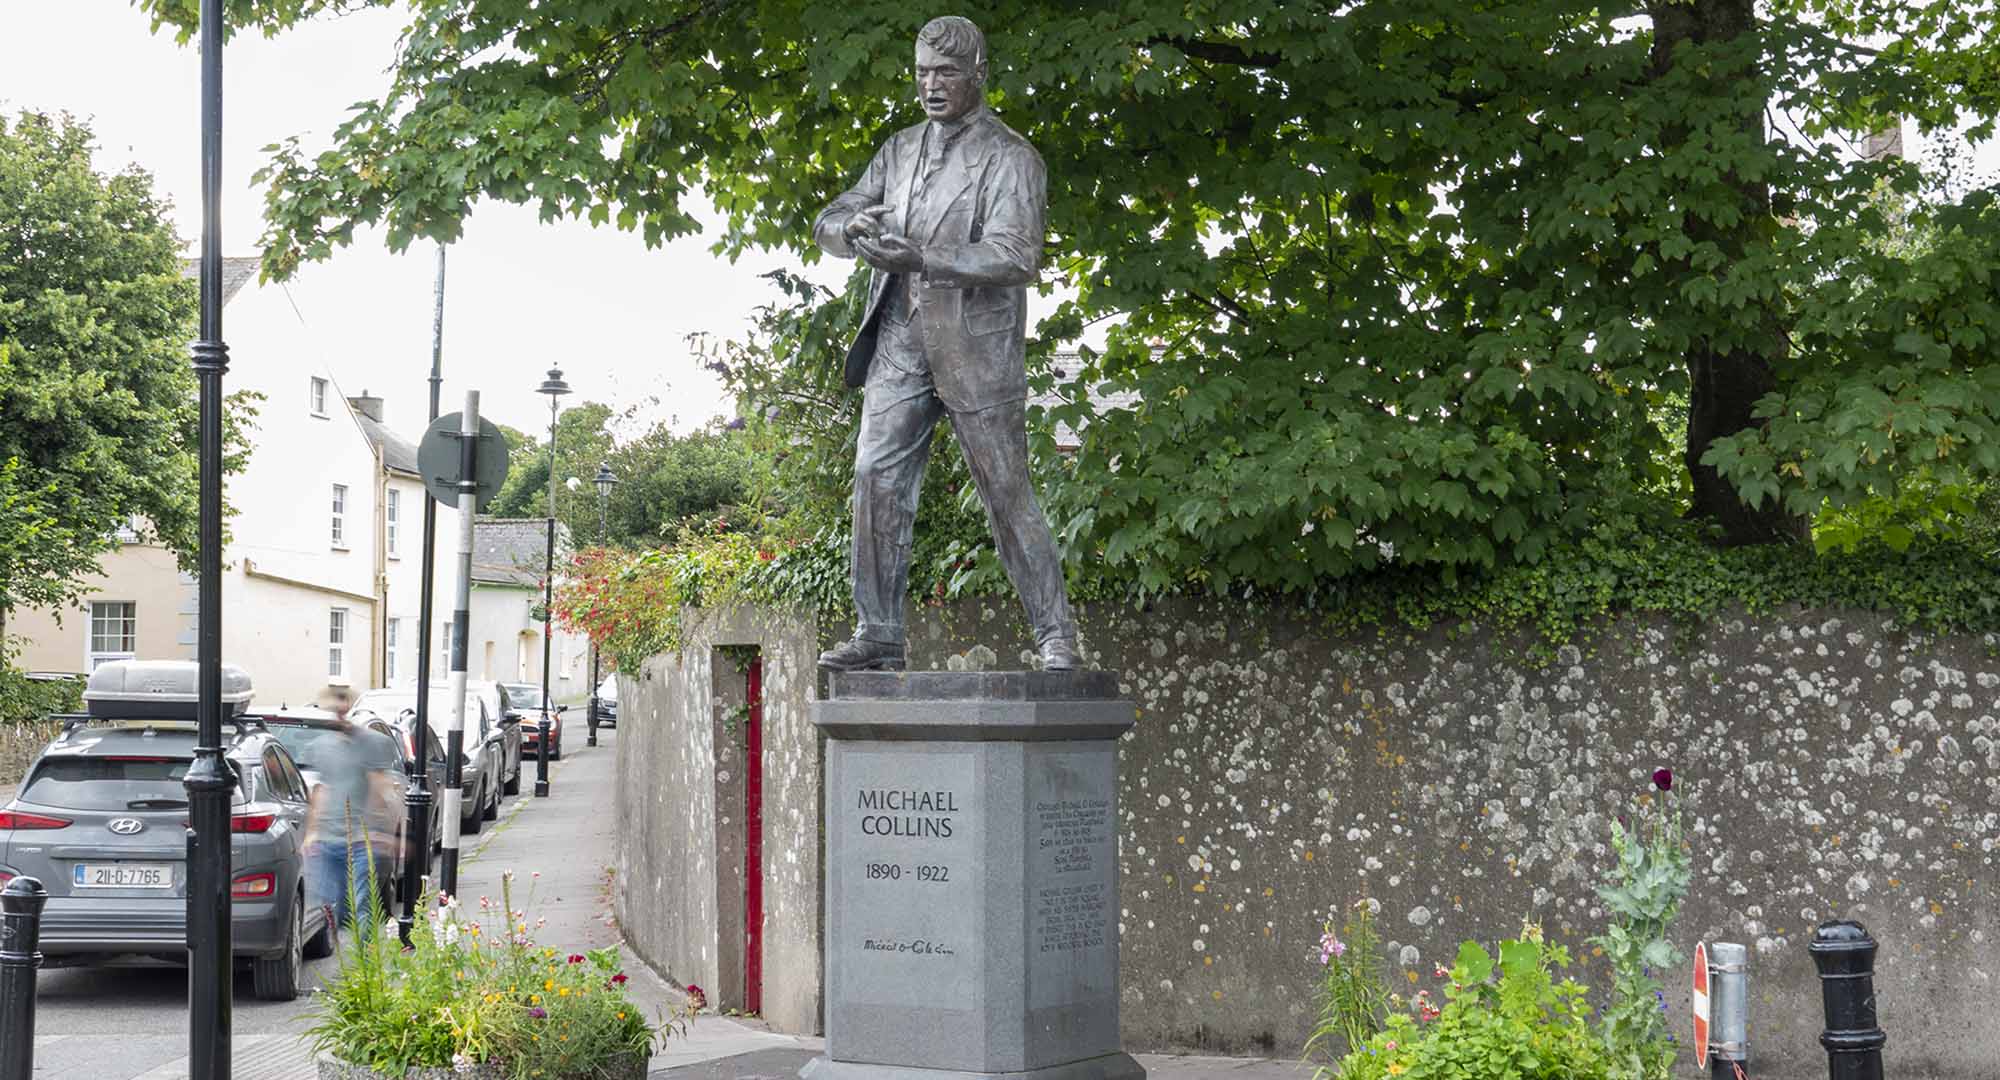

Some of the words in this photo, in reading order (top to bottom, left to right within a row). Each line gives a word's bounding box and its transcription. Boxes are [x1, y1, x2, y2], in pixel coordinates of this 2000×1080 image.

[858, 790, 958, 812] MICHAEL
[862, 816, 953, 838] COLLINS
[96, 869, 161, 885] 211-D-7765
[866, 864, 901, 880] 1890
[916, 866, 949, 882] 1922
